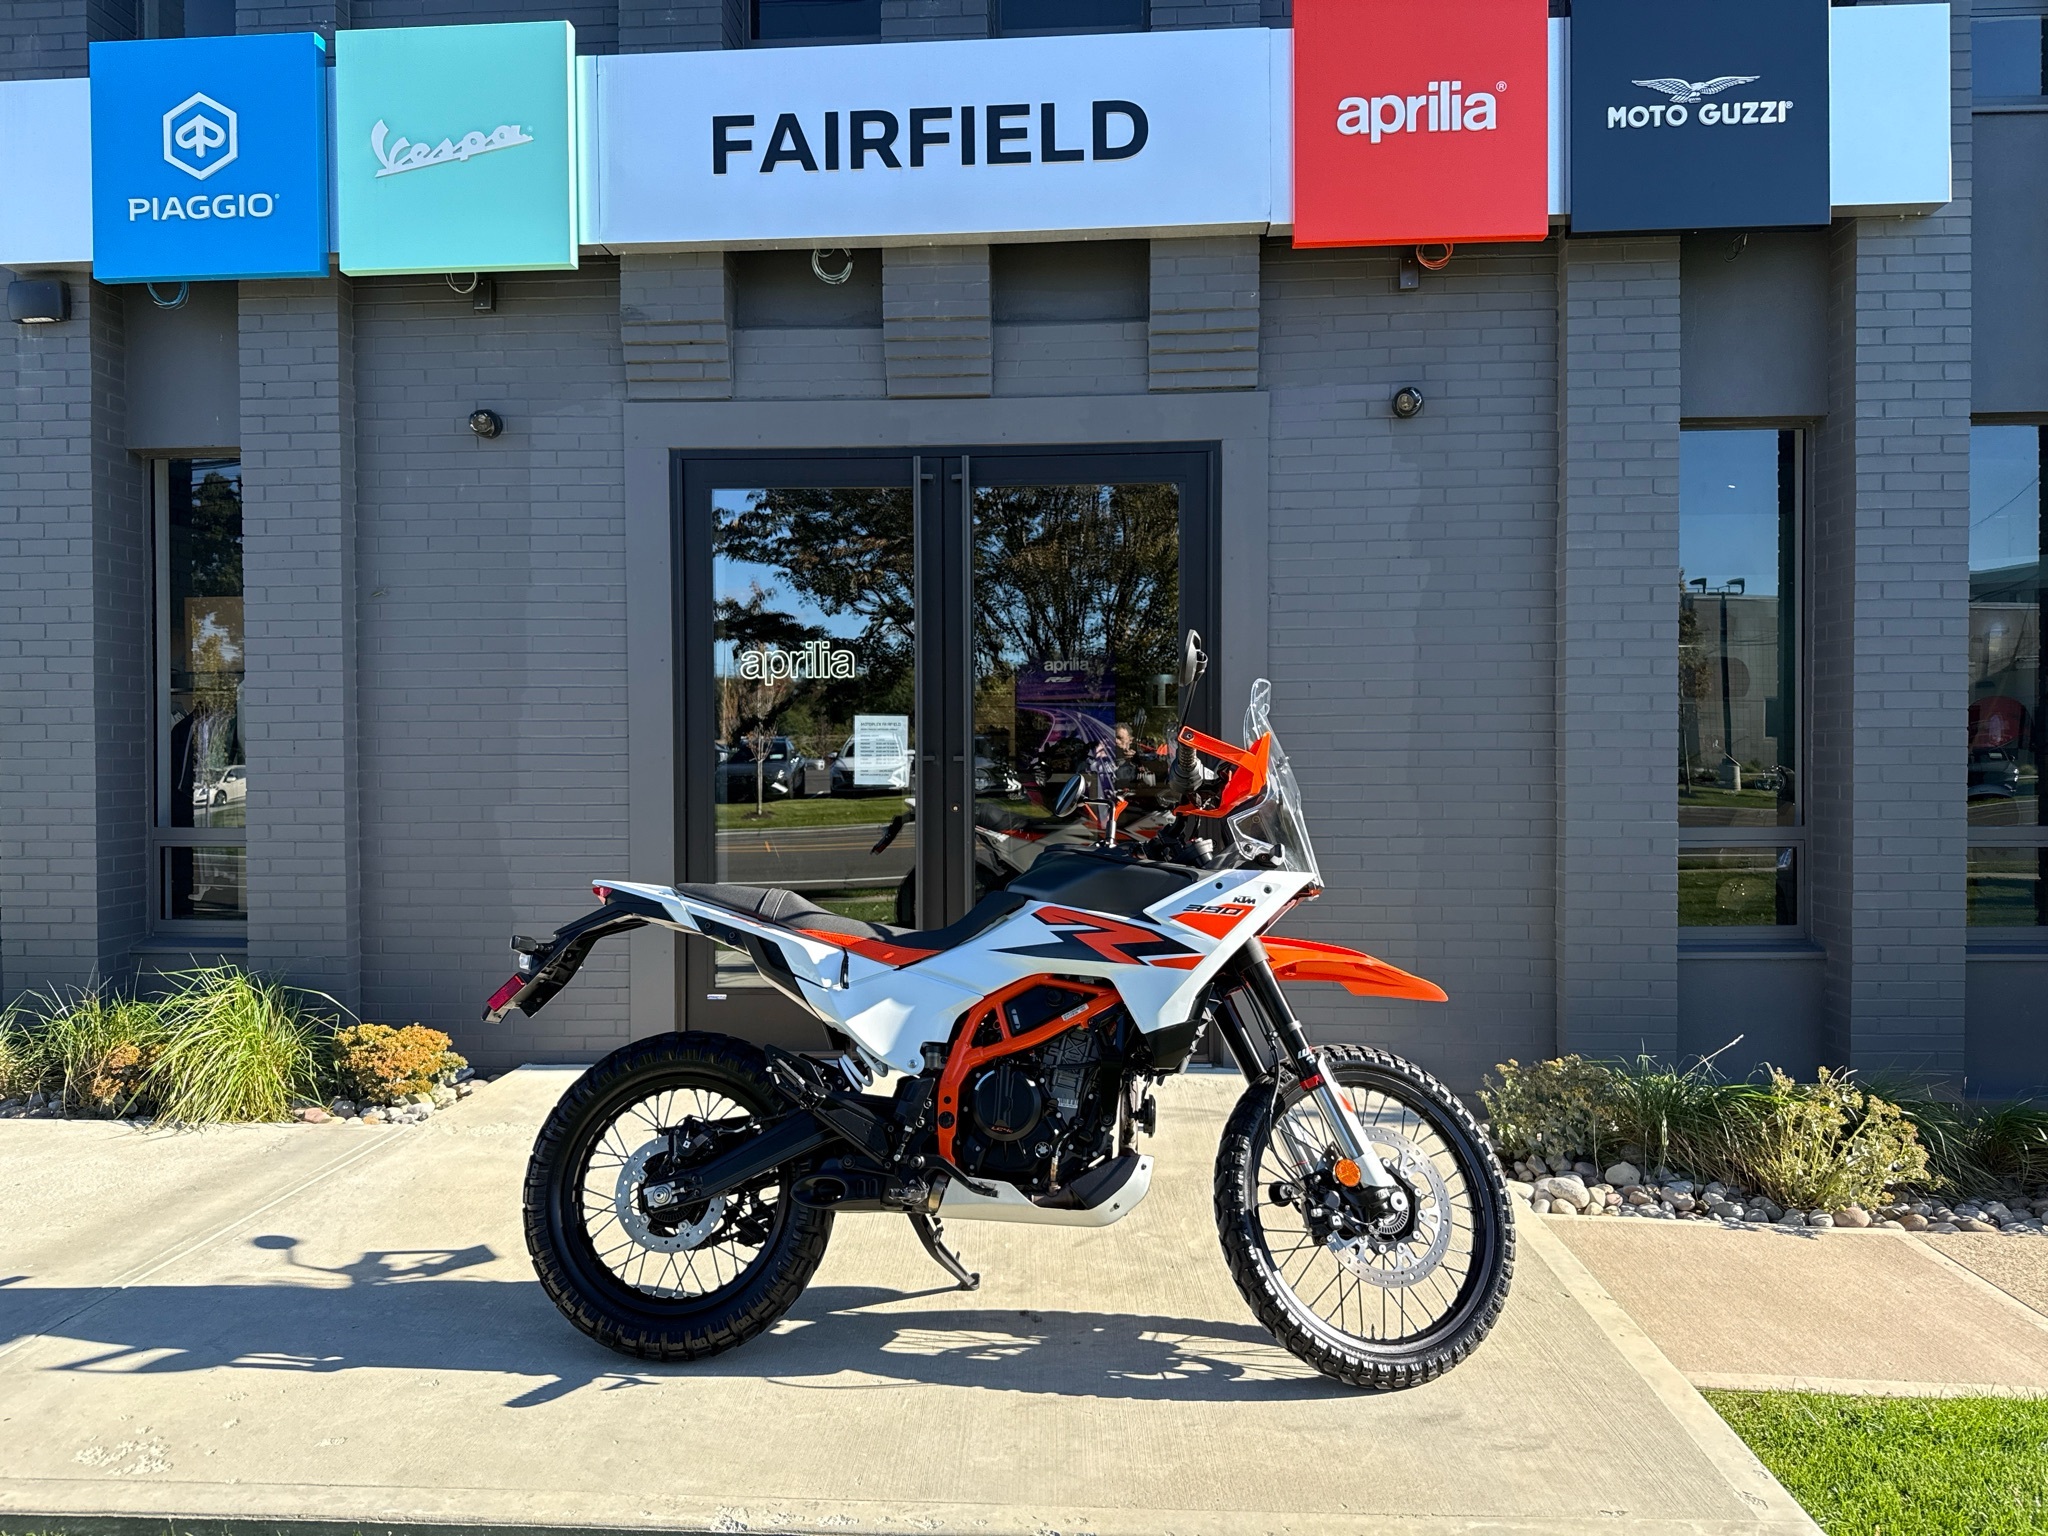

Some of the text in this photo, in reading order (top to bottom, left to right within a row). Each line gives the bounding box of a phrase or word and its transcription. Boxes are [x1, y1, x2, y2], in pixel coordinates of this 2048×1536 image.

[1336, 80, 1497, 144] aprilia
[1606, 100, 1788, 129] MOTO GUZZI
[371, 119, 535, 178] Vespa
[712, 100, 1150, 175] FAIRFIELD
[127, 193, 275, 222] PIAGGIO
[740, 640, 856, 687] aprilia
[1043, 656, 1090, 674] aprilia
[1182, 904, 1243, 915] 390
[1232, 895, 1257, 905] KTM
